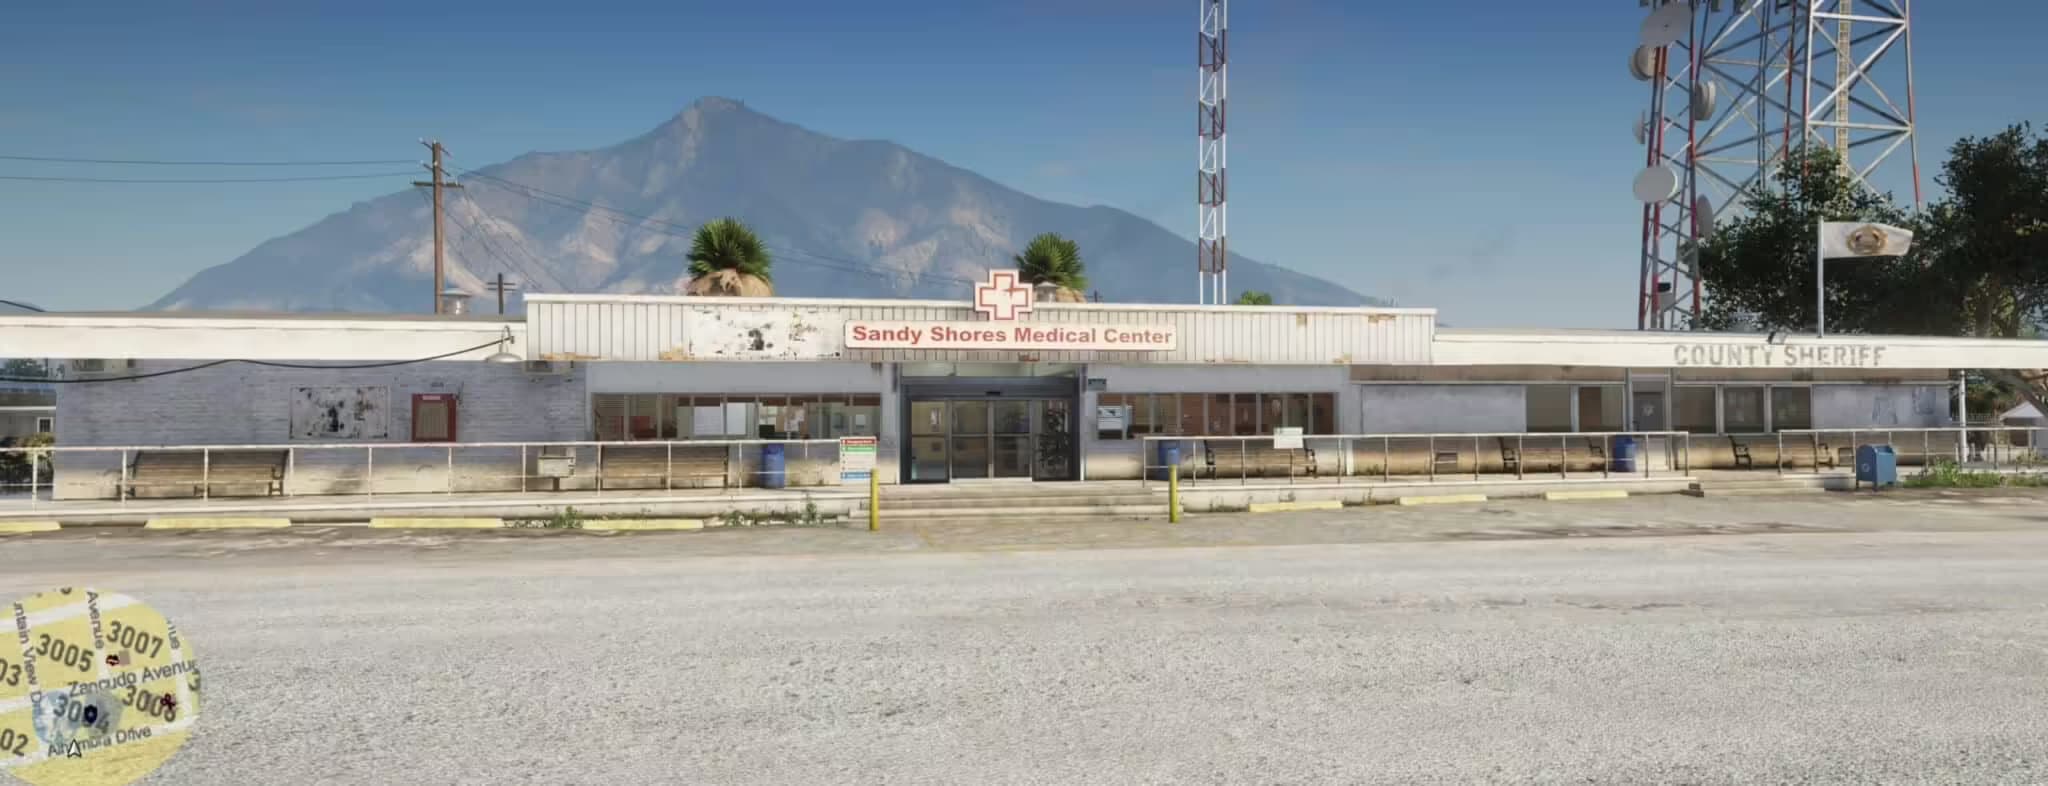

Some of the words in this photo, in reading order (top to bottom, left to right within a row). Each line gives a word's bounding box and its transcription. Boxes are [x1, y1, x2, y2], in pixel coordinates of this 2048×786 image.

[852, 325, 923, 345] Sandy
[930, 325, 1007, 343] Shores
[1014, 326, 1096, 344] Medical
[1103, 327, 1173, 344] Center
[1674, 344, 1774, 366] COUNTY
[1783, 344, 1887, 366] SHERIFF
